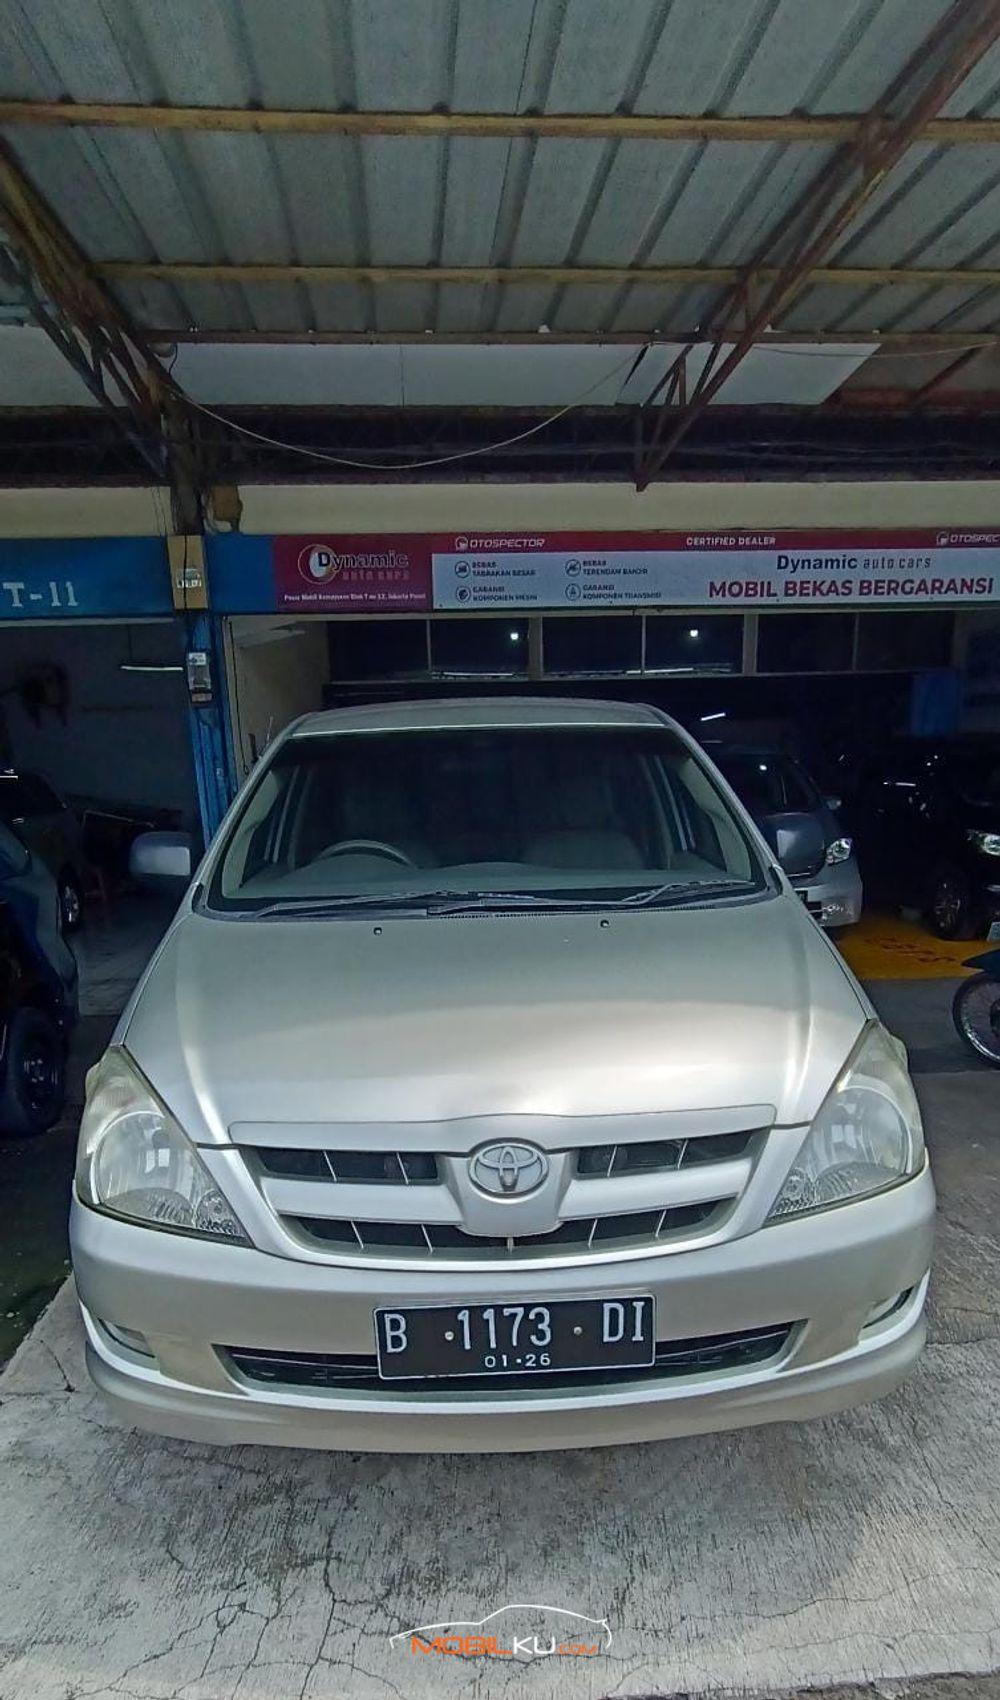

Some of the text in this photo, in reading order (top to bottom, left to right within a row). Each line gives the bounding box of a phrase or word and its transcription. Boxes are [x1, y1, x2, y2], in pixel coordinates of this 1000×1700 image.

[470, 539, 545, 548] OTOSPECTOR
[686, 536, 776, 546] CERTIFIED DEALER
[317, 550, 409, 570] Dynamic
[777, 553, 931, 573] Dynamic auto cars
[3, 581, 78, 607] T-11
[709, 577, 994, 598] MOBIL BEKAS BERGARANSI
[384, 1301, 645, 1353] B 1173 DI
